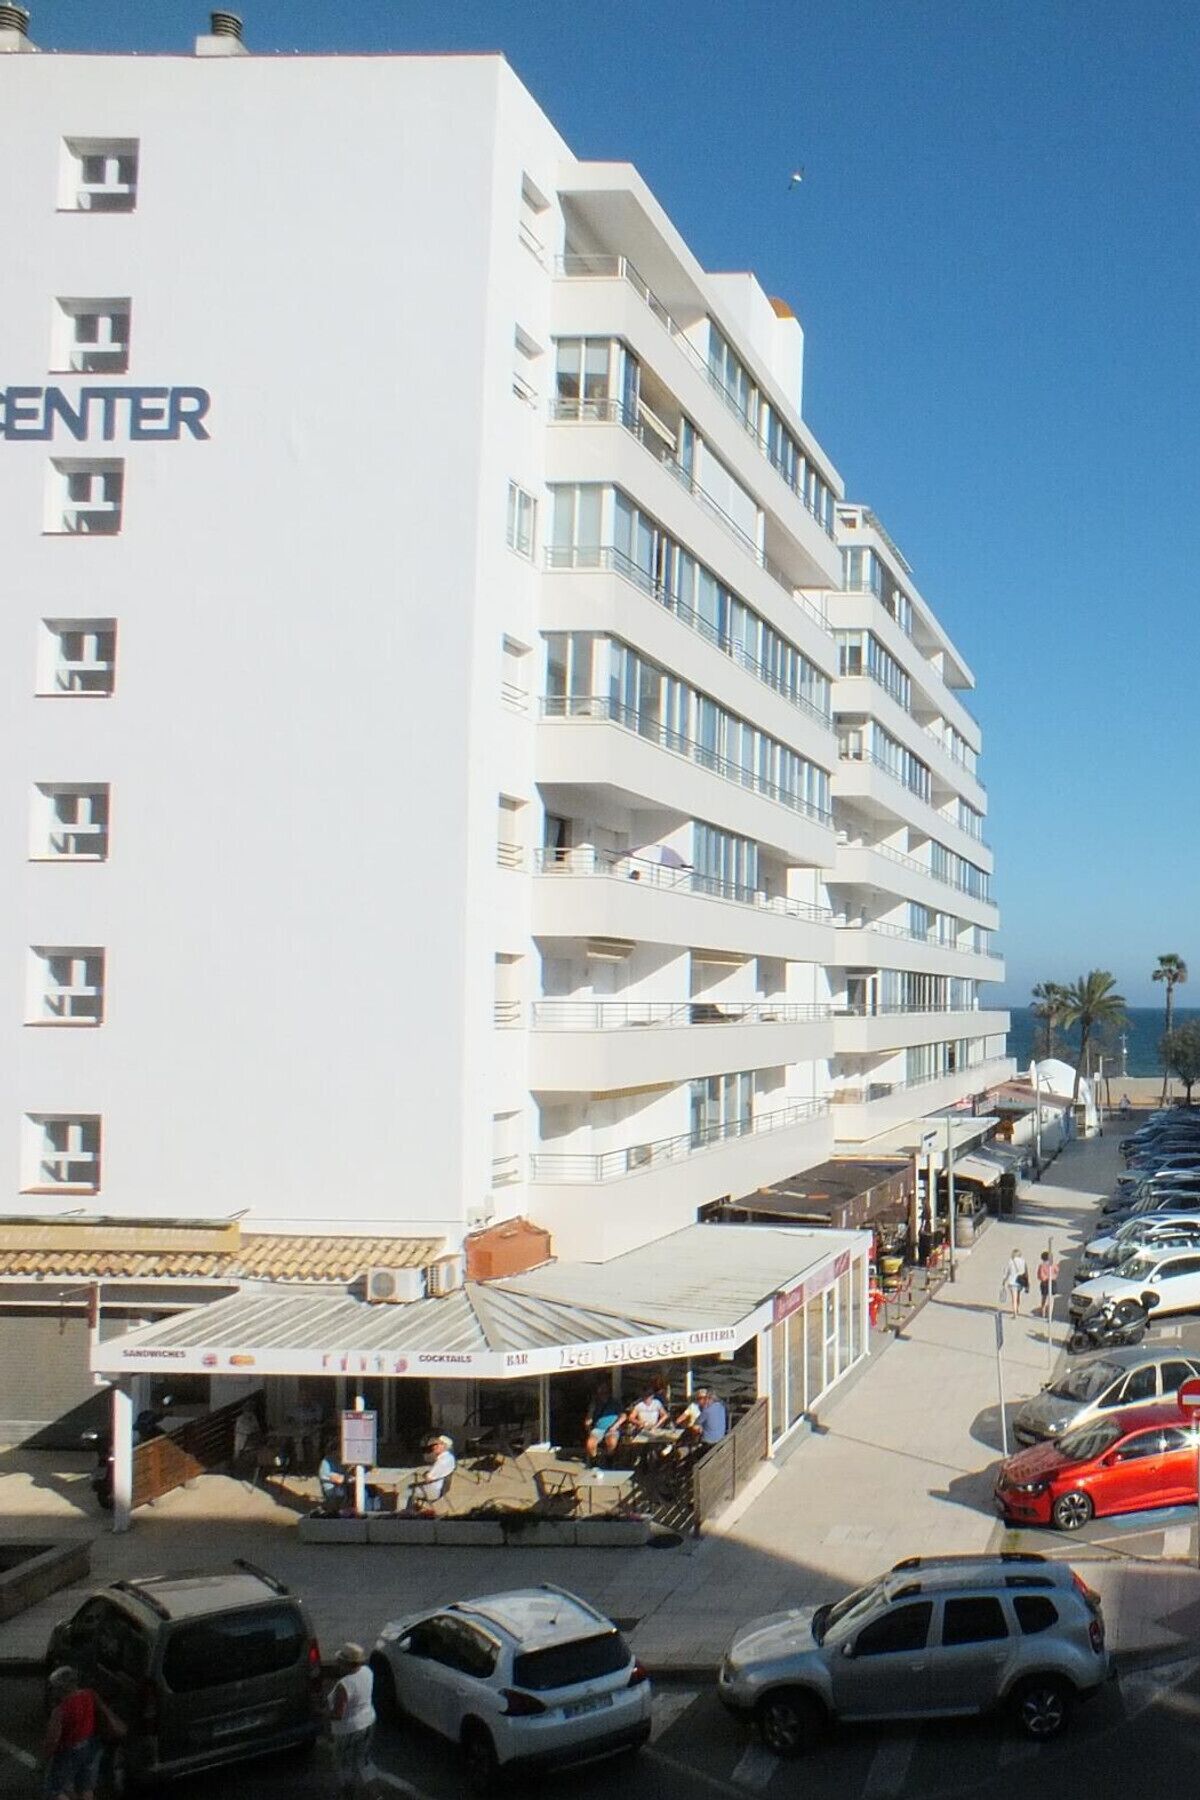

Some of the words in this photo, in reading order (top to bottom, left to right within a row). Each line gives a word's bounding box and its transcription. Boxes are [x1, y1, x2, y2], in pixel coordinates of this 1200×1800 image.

[0, 386, 211, 441] ENTER
[122, 1349, 186, 1358] SANDWICHES
[418, 1353, 472, 1363] COCKTAILS
[506, 1353, 528, 1366] BAR
[559, 1346, 592, 1369] La
[689, 1329, 736, 1344] CAFETERIA
